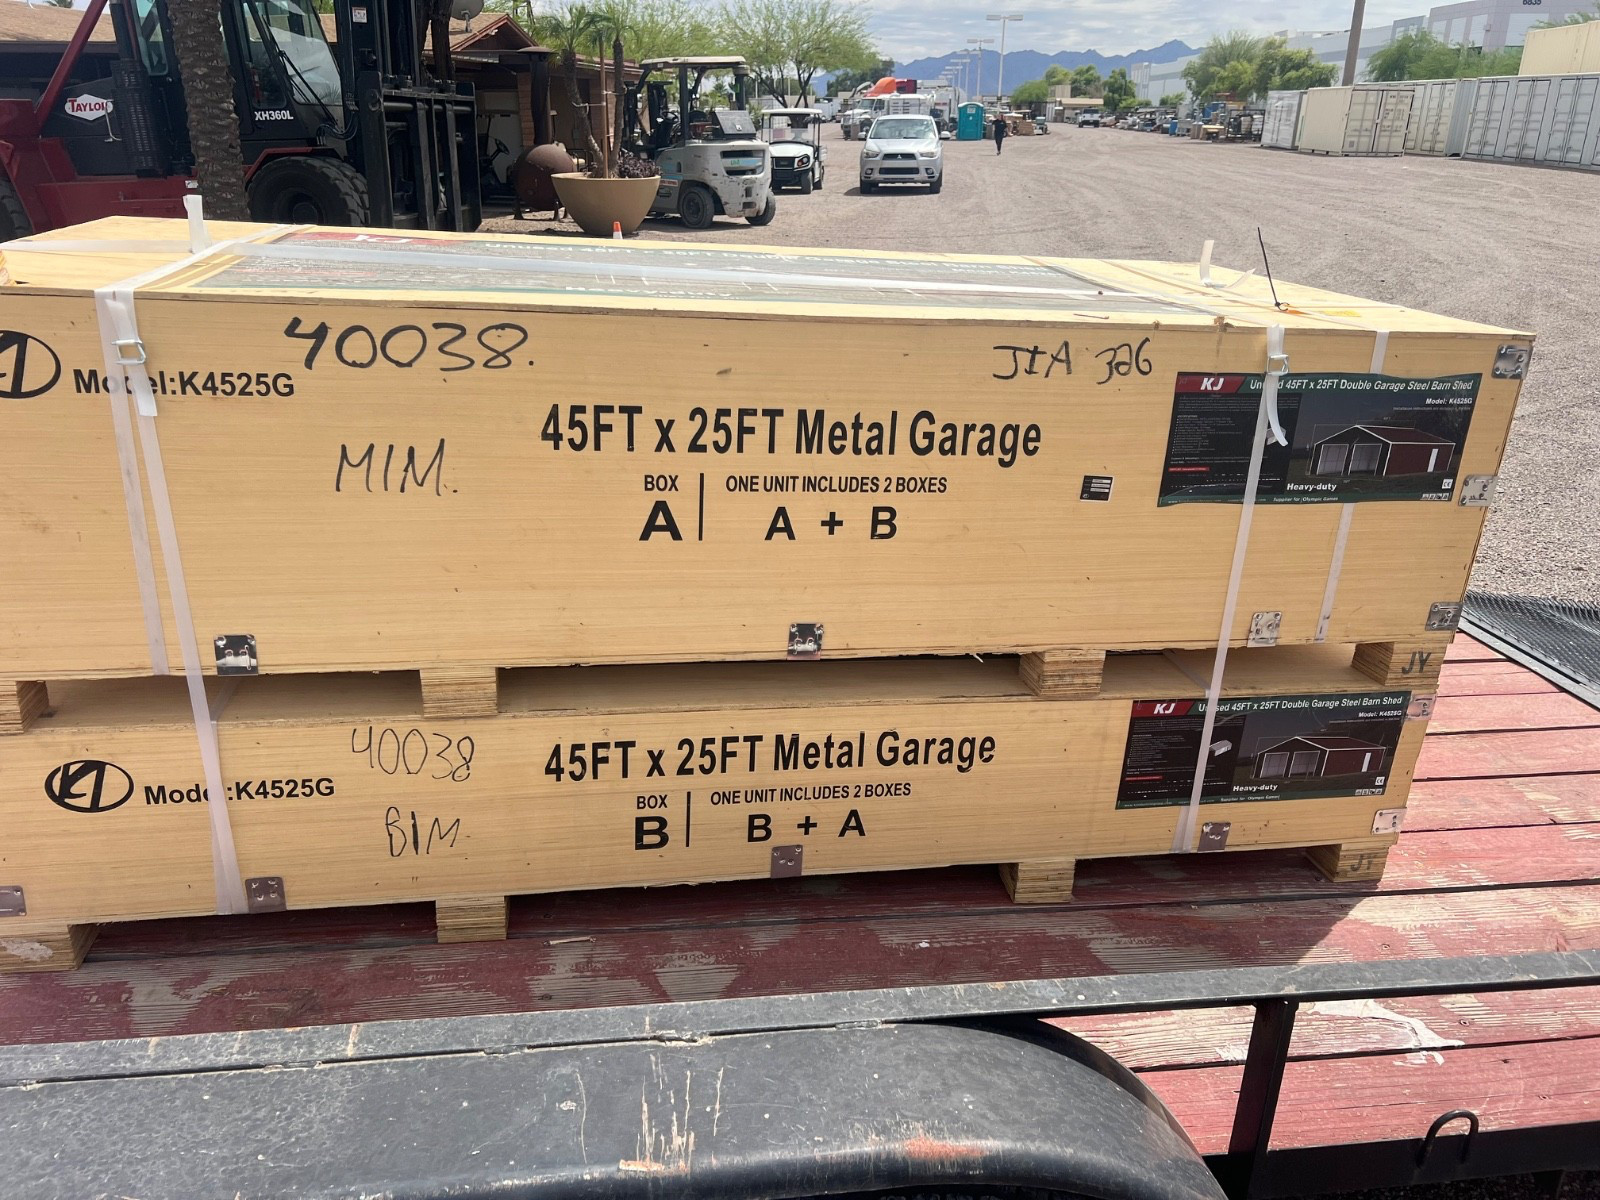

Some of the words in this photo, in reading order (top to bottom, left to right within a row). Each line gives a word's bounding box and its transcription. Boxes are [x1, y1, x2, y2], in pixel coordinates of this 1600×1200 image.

[254, 109, 294, 121] XH360L
[1200, 377, 1226, 391] KJ
[1285, 379, 1308, 389] 45FT
[1308, 381, 1315, 389] x
[1316, 379, 1339, 389] 25FT
[1339, 379, 1372, 390] Double
[1374, 380, 1406, 392] Garage
[1407, 381, 1430, 390] Steel
[1431, 381, 1451, 390] Barn
[1452, 380, 1474, 390] Shed
[541, 404, 642, 452] 45FT
[655, 419, 675, 452] x
[688, 407, 784, 454] 25FT
[796, 409, 897, 455] Metal
[910, 411, 1041, 468] Garage
[645, 475, 678, 491] BOX
[726, 475, 759, 492] ONE
[764, 476, 799, 492] UNIT
[803, 476, 879, 492] INCLUDES
[884, 477, 892, 492] 2
[896, 477, 947, 493] BOXES
[1286, 483, 1337, 491] Heavy-duty
[639, 501, 682, 541] A
[765, 507, 795, 540] A
[871, 506, 896, 539] B
[1402, 651, 1431, 675] JY
[1154, 703, 1176, 714] KJ
[1231, 702, 1252, 712] 45FT
[1260, 701, 1280, 710] 25FT
[1281, 700, 1310, 709] Double
[1311, 699, 1340, 709] Garage
[1341, 698, 1360, 706] Steel
[1362, 698, 1381, 706] Barn
[1382, 696, 1402, 705] Shed
[545, 741, 636, 782] 45FT
[646, 750, 665, 777] x
[676, 735, 763, 775] 25FT
[774, 732, 865, 770] Metal
[877, 730, 995, 773] Garage
[711, 790, 741, 805] ONE
[745, 789, 777, 803] UNIT
[780, 785, 849, 801] INCLUDES
[854, 785, 861, 798] 2
[865, 783, 911, 797] BOXES
[1232, 784, 1278, 792] Heavy-duty
[637, 795, 667, 809] BOX
[635, 816, 669, 850] B
[748, 814, 772, 842] B
[838, 809, 866, 837] A
